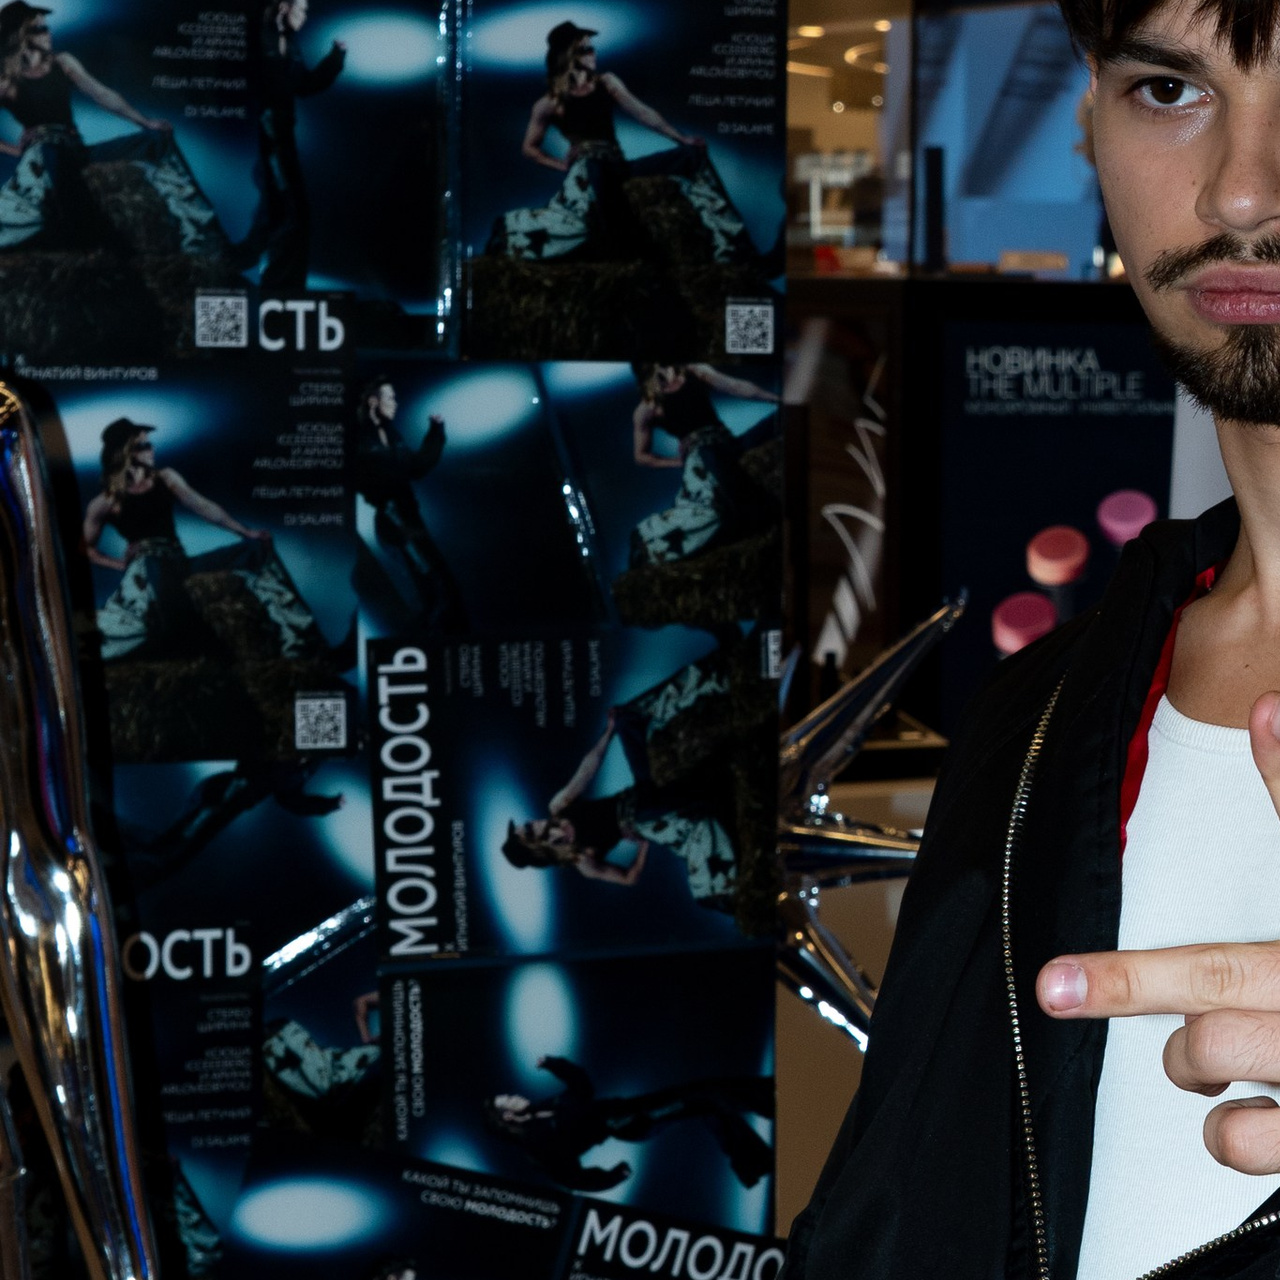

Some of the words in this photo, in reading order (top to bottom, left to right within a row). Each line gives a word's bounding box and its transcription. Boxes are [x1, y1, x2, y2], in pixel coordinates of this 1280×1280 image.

[965, 345, 1101, 376] НОВИНКА
[968, 372, 1016, 400] THE
[1022, 370, 1144, 401] MULTIPLE
[377, 645, 441, 956] МОЛОДОСТЬ
